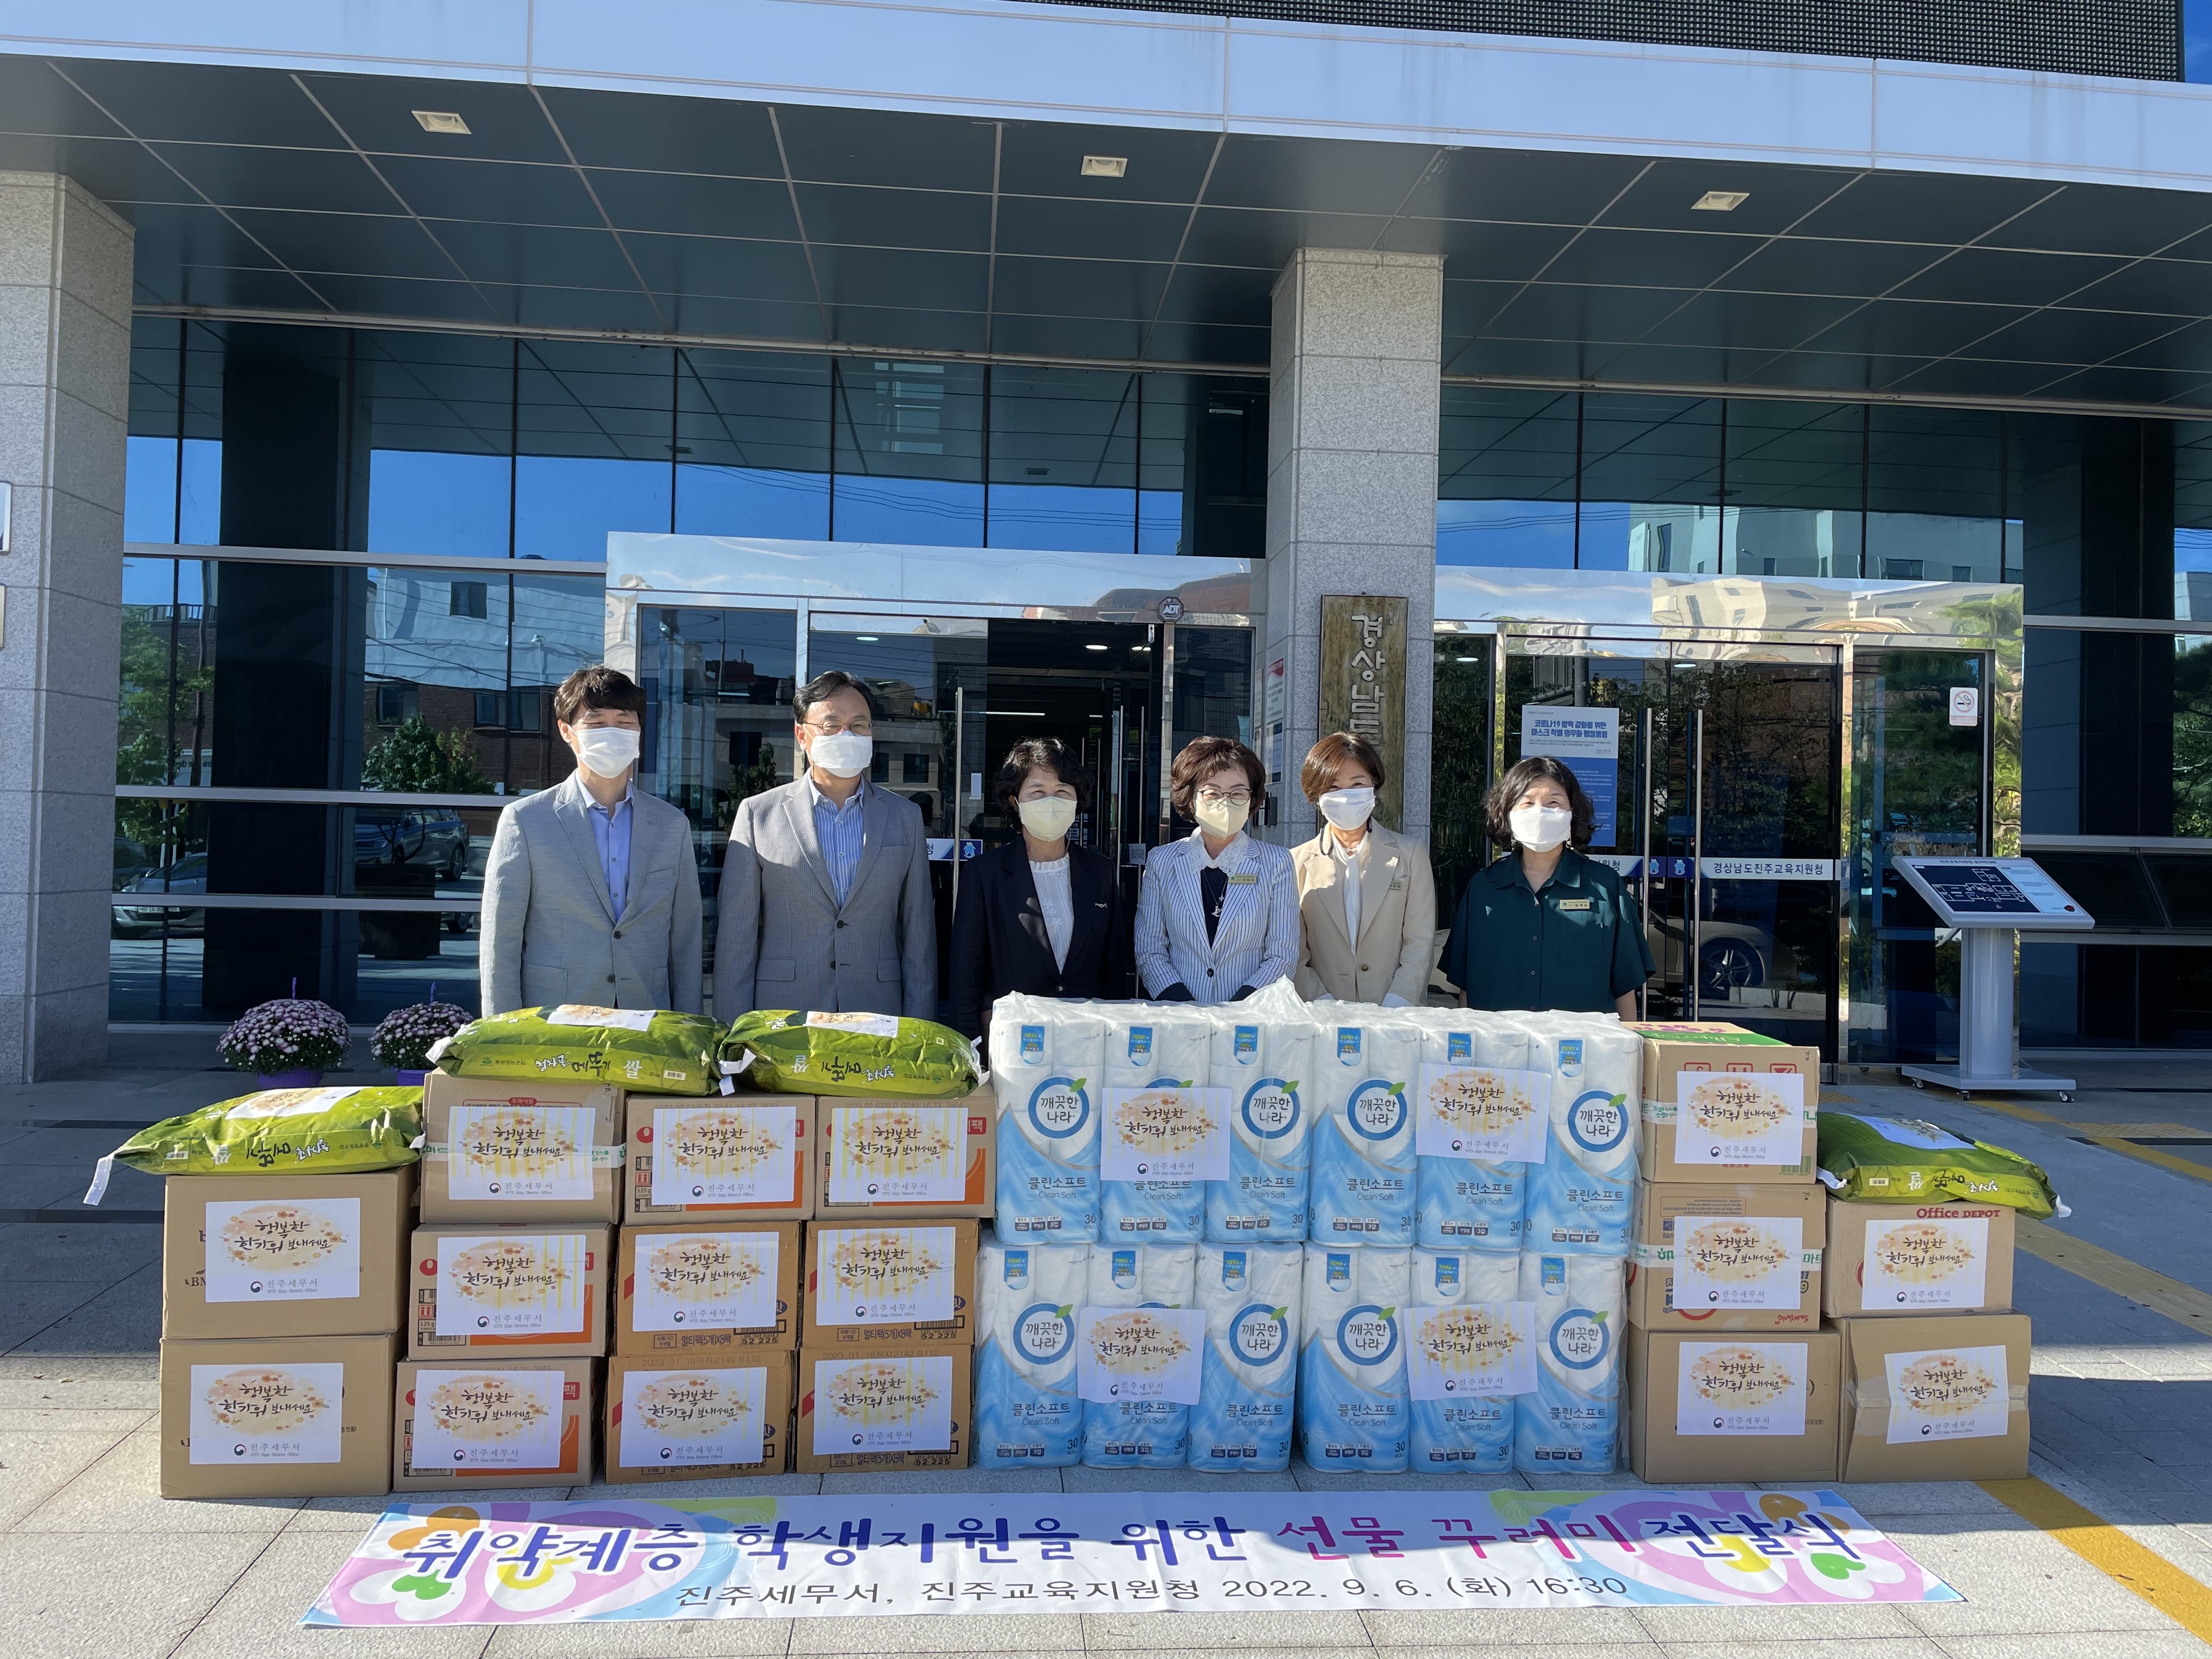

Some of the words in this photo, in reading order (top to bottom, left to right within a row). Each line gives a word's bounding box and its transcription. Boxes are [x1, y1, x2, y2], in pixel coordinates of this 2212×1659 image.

[1163, 605, 1180, 614] ADT
[1714, 862, 1824, 876] 경상남도진주교육지원청
[534, 1053, 572, 1073] 청자골
[572, 1051, 611, 1077] 메뚜기
[623, 1059, 642, 1080] 쌀
[791, 1054, 809, 1074] 쌀
[821, 1056, 861, 1082] 메뚜기
[860, 1064, 895, 1082] 청자골
[1458, 1084, 1505, 1104] 행복한
[1716, 1090, 1762, 1109] 행복한
[1041, 1095, 1079, 1110] 깨끗한
[1254, 1096, 1290, 1110] 깨끗한
[1359, 1098, 1397, 1112] 깨끗한
[1440, 1097, 1482, 1116] 한가위
[1486, 1105, 1522, 1117] 보내세요
[1047, 1111, 1071, 1124] 나라
[1142, 1106, 1188, 1124] 행복한
[1259, 1111, 1283, 1124] 나라
[1365, 1113, 1390, 1126] 나라
[1580, 1109, 1618, 1124] 깨끗한
[1700, 1104, 1740, 1122] 한가위
[1743, 1110, 1780, 1121] 보내세요
[697, 1126, 748, 1145] 행복한
[873, 1126, 922, 1144] 행복한
[1125, 1121, 1166, 1138] 한가위
[1170, 1126, 1206, 1136] 보내세요
[1587, 1125, 1611, 1137] 나라
[290, 1138, 330, 1161] 청자골
[678, 1142, 724, 1159] 한가위
[728, 1146, 769, 1156] 보내세요
[855, 1141, 898, 1158] 한가위
[902, 1147, 941, 1155] 보내세요
[1466, 1140, 1508, 1150] 진주세무서
[1724, 1146, 1766, 1154] 진주세무서
[211, 1144, 232, 1166] 쌀
[1152, 1162, 1194, 1171] 진주세무서
[708, 1183, 754, 1193] 진주세무서
[883, 1183, 927, 1191] 진주세무서
[1028, 1176, 1087, 1189] 클린소프트
[1240, 1176, 1296, 1189] 클린소프트
[1908, 1171, 1925, 1191] 쌀
[1964, 1180, 1999, 1193] 청자골
[1061, 1190, 1077, 1199] Soft
[1271, 1190, 1285, 1199] Soft
[1567, 1189, 1624, 1202] 클린소프트
[1577, 1204, 1598, 1212] Clean
[1599, 1204, 1614, 1212] Soft
[1916, 1207, 1959, 1218] Office
[1962, 1210, 2001, 1218] DEPOT
[255, 1218, 310, 1239] 행복한
[1510, 1221, 1521, 1231] 30
[234, 1235, 284, 1254] 한가위
[288, 1239, 332, 1250] 보내세요
[1714, 1235, 1759, 1253] 행복한
[1903, 1237, 1947, 1254] 행복한
[680, 1251, 731, 1271] 행복한
[860, 1246, 910, 1266] 행복한
[1697, 1249, 1737, 1266] 한가위
[1741, 1255, 1778, 1265] 보내세요
[1886, 1251, 1925, 1267] 한가위
[1929, 1256, 1964, 1265] 보내세요
[482, 1255, 535, 1275] 행복한
[842, 1262, 885, 1280] 한가위
[890, 1266, 929, 1277] 보내세요
[462, 1271, 510, 1289] 한가위
[515, 1276, 557, 1286] 보내세요
[660, 1267, 706, 1285] 한가위
[710, 1271, 751, 1282] 보내세요
[267, 1279, 317, 1289] 진주세무서
[1723, 1290, 1764, 1299] 진주세무서
[1910, 1290, 1950, 1299] 진주세무서
[690, 1309, 736, 1318] 진주세무서
[871, 1304, 915, 1313] 진주세무서
[494, 1314, 541, 1323] 진주세무서
[1778, 1314, 1809, 1323] SAMYANG
[864, 1328, 912, 1340] 멀티팩(5개)X8팩
[1026, 1322, 1064, 1336] 깨끗한
[1242, 1323, 1279, 1337] 깨끗한
[1349, 1323, 1387, 1337] 깨끗한
[1562, 1327, 1600, 1341] 깨끗한
[681, 1334, 732, 1347] 멀티팩(5개)X8팩
[1032, 1337, 1057, 1350] 나라
[1248, 1339, 1272, 1351] 나라
[1356, 1339, 1380, 1351] 나라
[1568, 1342, 1593, 1355] 나라
[1719, 1361, 1765, 1379] 행복한
[1702, 1375, 1742, 1392] 한가위
[1746, 1381, 1783, 1391] 보내세요
[239, 1383, 294, 1402] 행복한
[667, 1387, 719, 1407] 행복한
[219, 1399, 267, 1417] 한가위
[272, 1404, 315, 1414] 보내세요
[648, 1403, 693, 1421] 한가위
[698, 1408, 738, 1418] 보내세요
[1012, 1402, 1071, 1417] 클린소프트
[1338, 1404, 1397, 1417] 클린소프트
[1348, 1418, 1369, 1426] Clean
[1371, 1418, 1386, 1426] Soft
[1728, 1417, 1769, 1425] 진주세무서
[250, 1443, 300, 1452] 진주세무서
[676, 1446, 723, 1455] 진주세무서
[856, 1453, 905, 1465] 멀티팩(5개)X8팩
[403, 1521, 697, 1579] 취약계층
[734, 1516, 1080, 1571] 학생지원을
[1110, 1516, 1247, 1566] 위한
[1277, 1515, 1404, 1560] 선물
[1431, 1514, 1637, 1560] 꾸러미
[1645, 1513, 1862, 1560] 전달식
[676, 1582, 894, 1607] 진주세무서,
[921, 1578, 1199, 1602] 진주교육지원청
[1222, 1579, 1328, 1598] 2022.
[1346, 1578, 1380, 1597] 9.
[1395, 1579, 1432, 1597] 6.
[1446, 1576, 1513, 1599] (화)
[1526, 1577, 1628, 1595] 16:30
